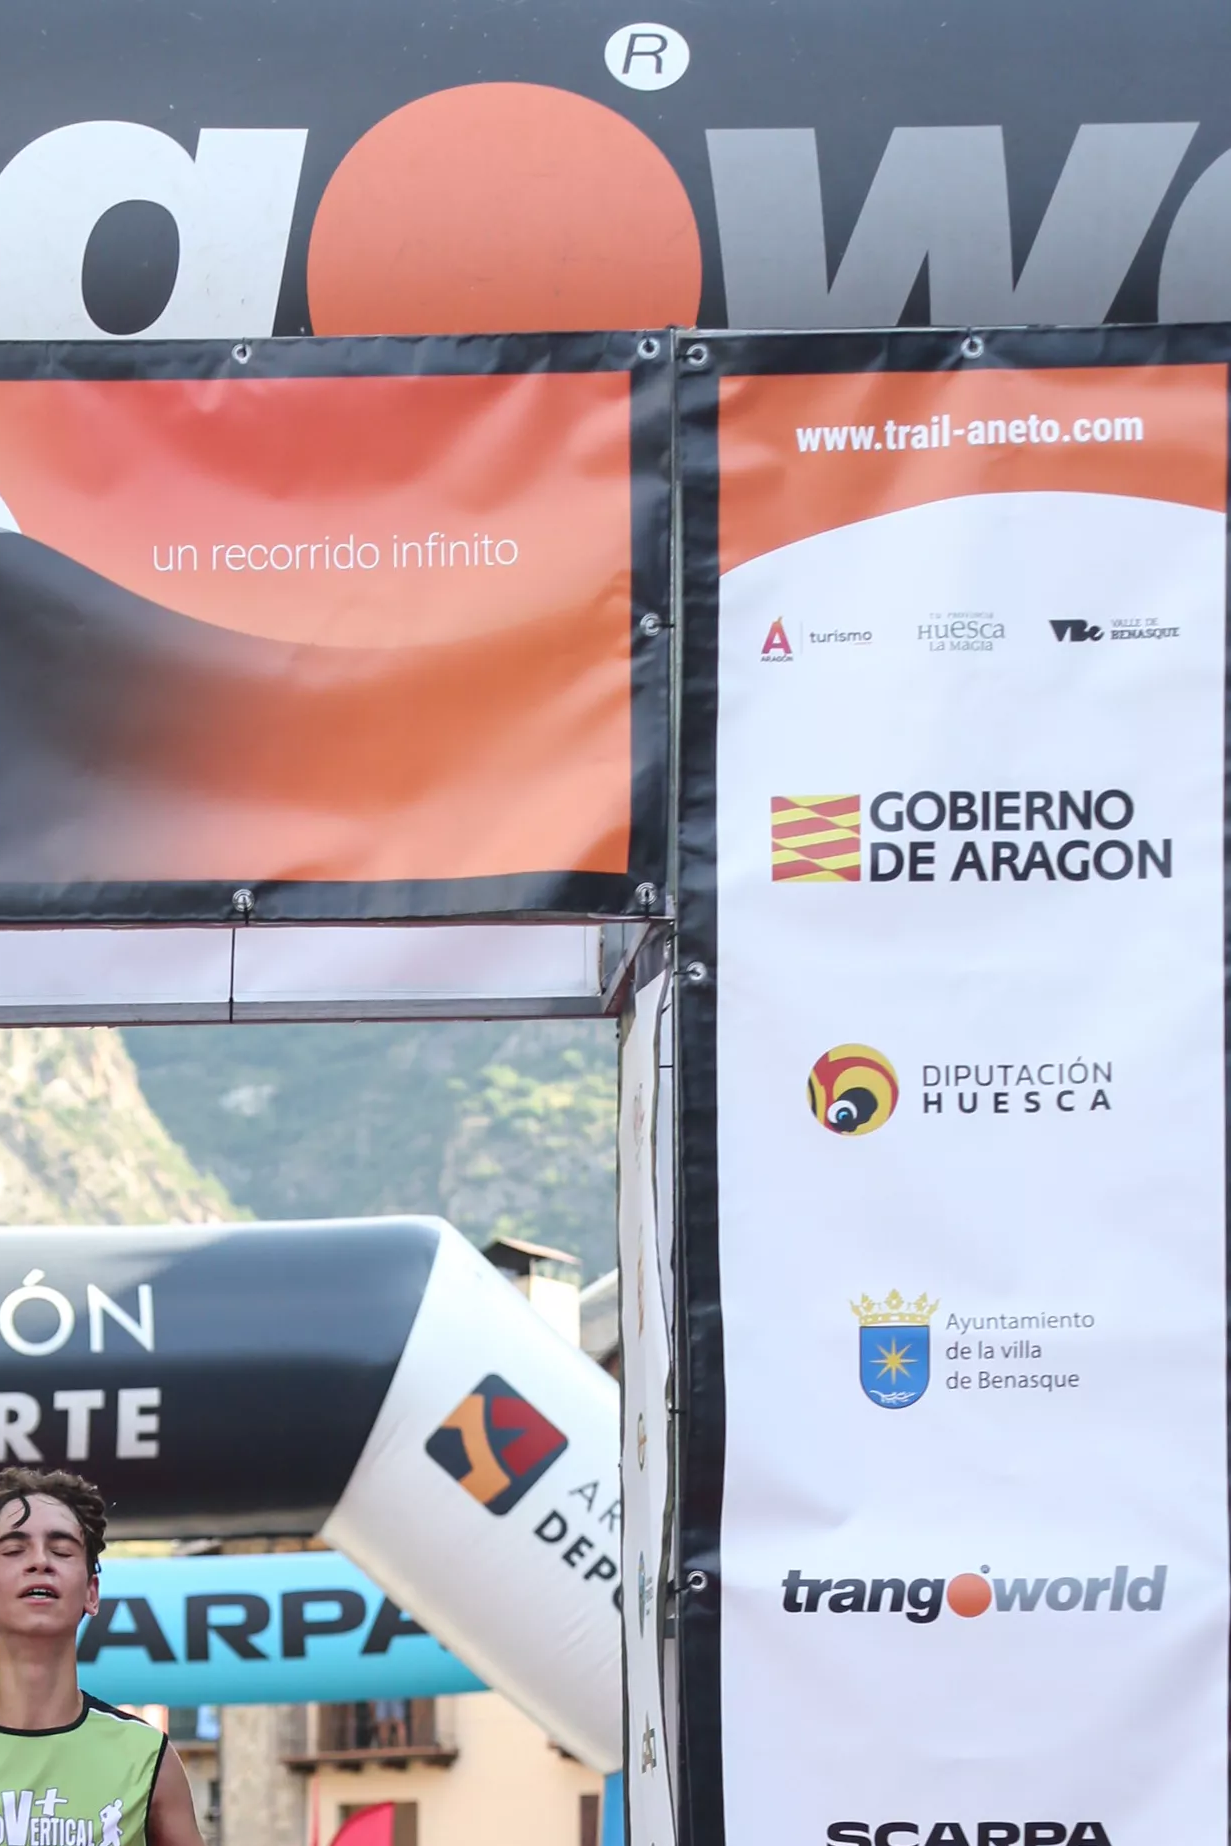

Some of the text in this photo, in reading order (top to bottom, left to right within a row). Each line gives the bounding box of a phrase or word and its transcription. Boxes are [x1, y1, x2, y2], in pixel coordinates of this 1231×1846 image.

[796, 414, 1144, 453] www.trail-aneto.com
[154, 532, 518, 571] un recorrido infinito
[1110, 617, 1158, 628] VALLE DE
[1110, 627, 1180, 640] BENASQUE
[809, 630, 873, 643] turismo
[870, 789, 1134, 832] GOBIERNO
[869, 838, 1173, 882] DE ARAGON
[923, 1057, 1113, 1087] DIPUTACIÓN
[923, 1090, 1112, 1113] HUESCA
[946, 1311, 1095, 1336] Ayuntamiento
[946, 1342, 1042, 1360] de la villa
[946, 1371, 1080, 1392] de Benasque
[781, 1566, 1168, 1624] trangoworld
